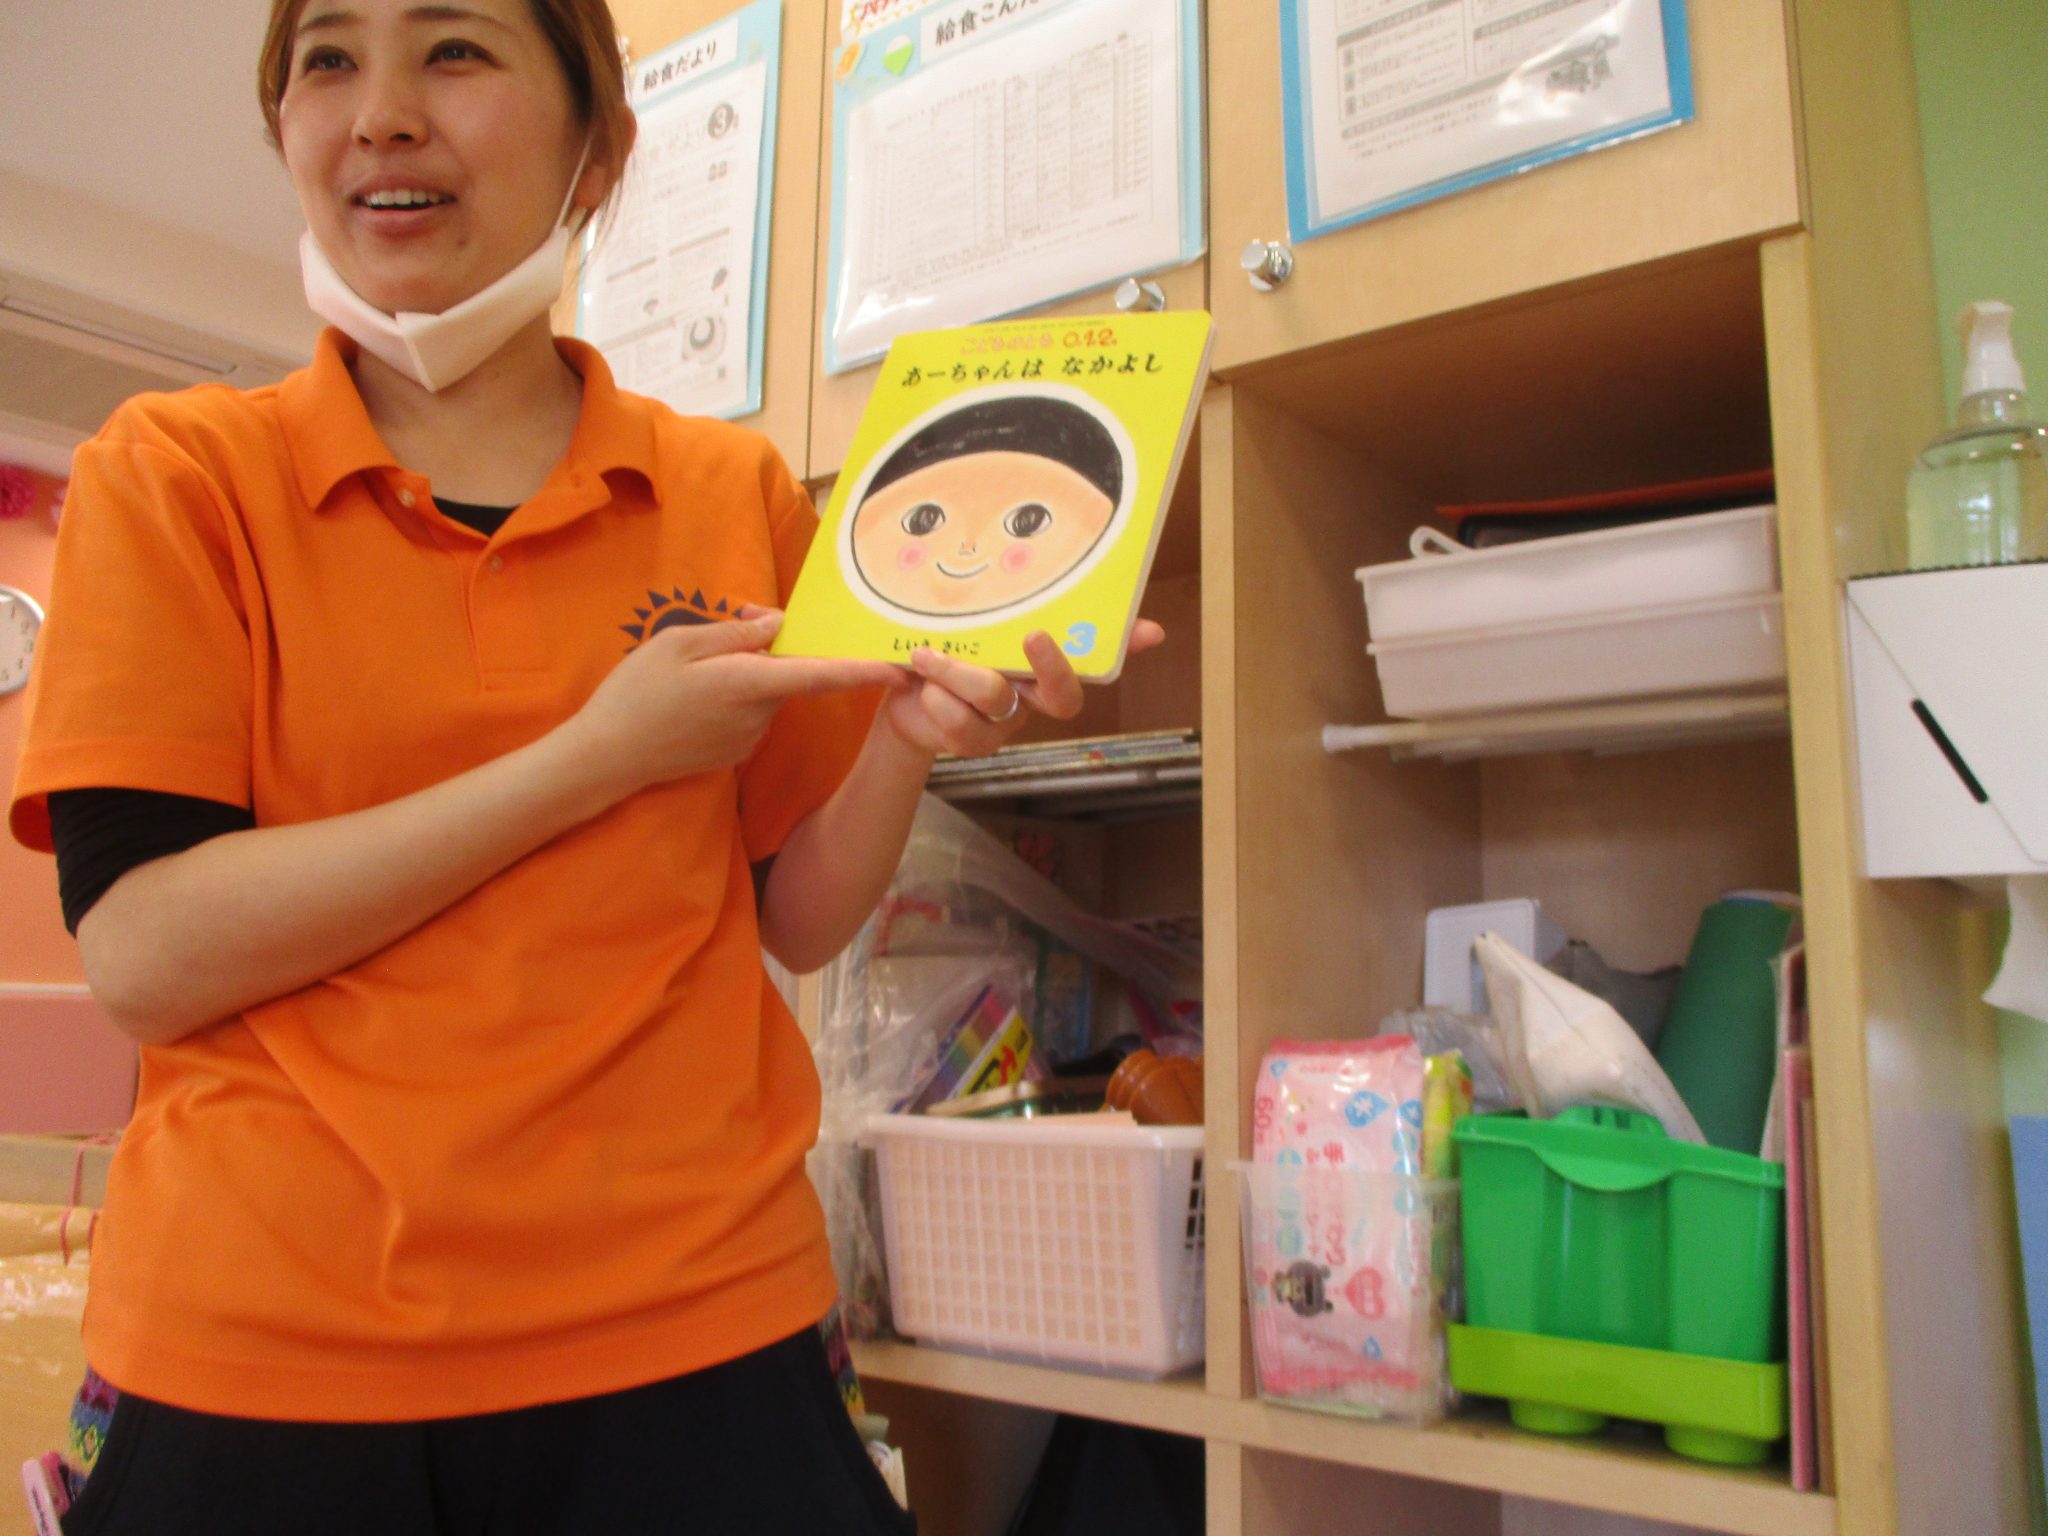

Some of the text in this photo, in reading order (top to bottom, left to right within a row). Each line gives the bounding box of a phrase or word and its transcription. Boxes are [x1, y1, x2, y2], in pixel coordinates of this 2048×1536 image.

[642, 40, 717, 92] 給食だより
[902, 352, 1163, 387] あーちゃんは なかよし
[1063, 621, 1098, 657] 3
